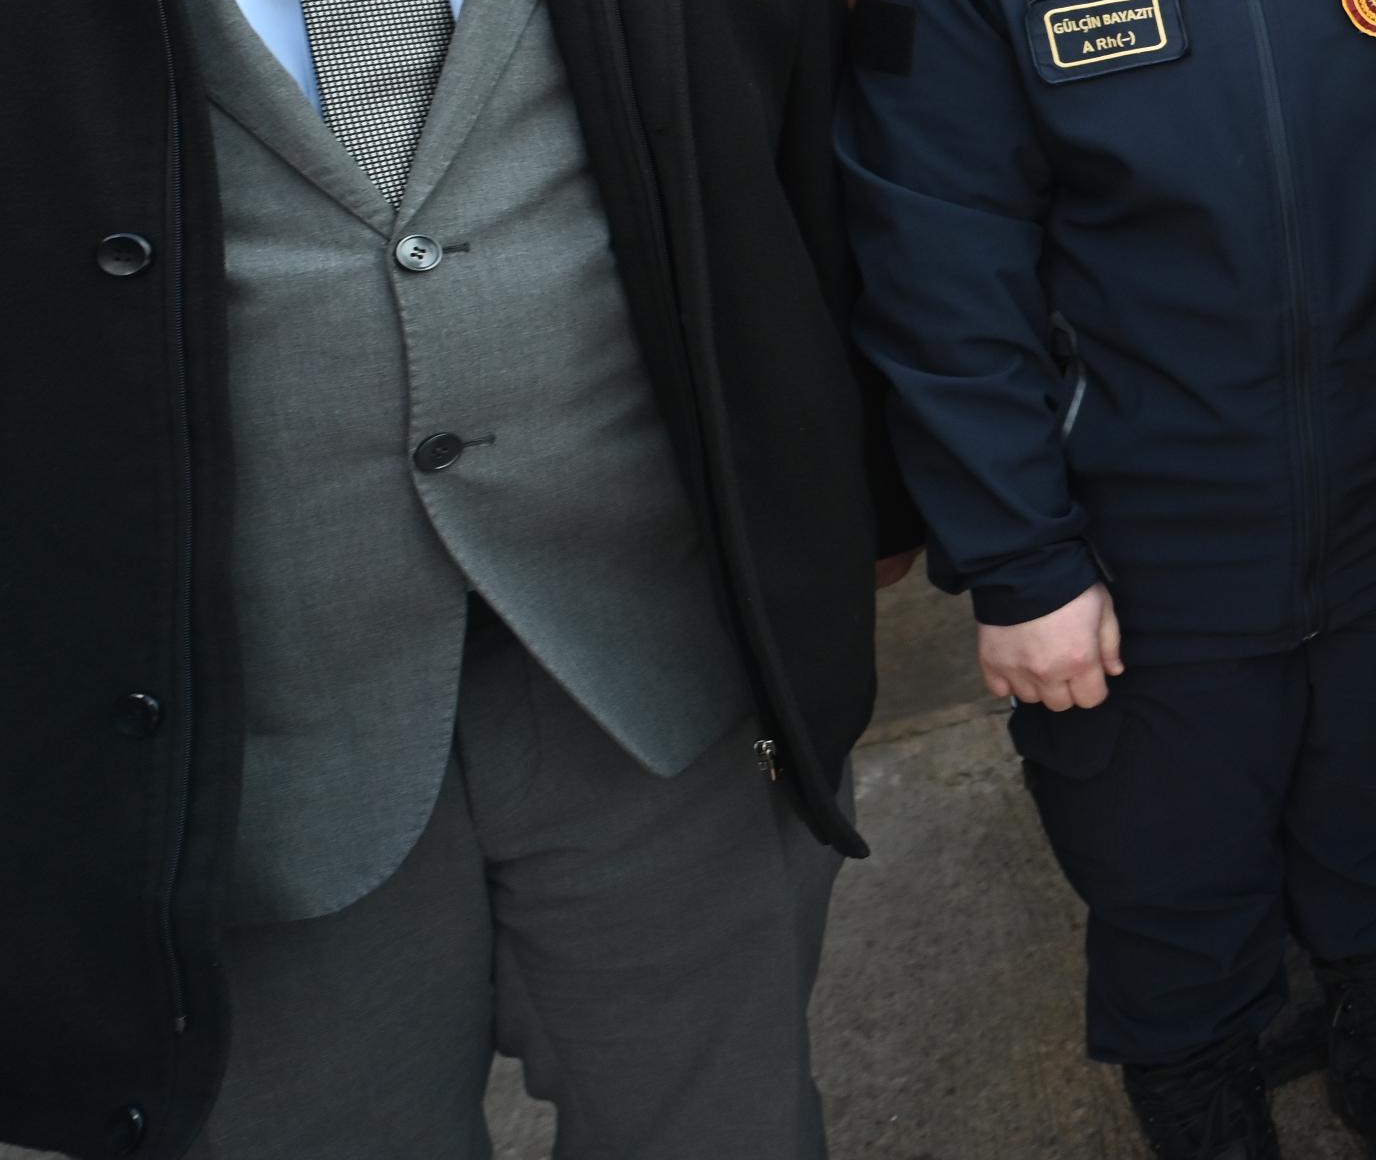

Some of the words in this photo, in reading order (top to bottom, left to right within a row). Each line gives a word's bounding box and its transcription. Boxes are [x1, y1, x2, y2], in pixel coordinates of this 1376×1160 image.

[1053, 14, 1102, 34] GÜLÇİN
[1102, 6, 1154, 25] BAYAZIT
[1082, 40, 1095, 54] A
